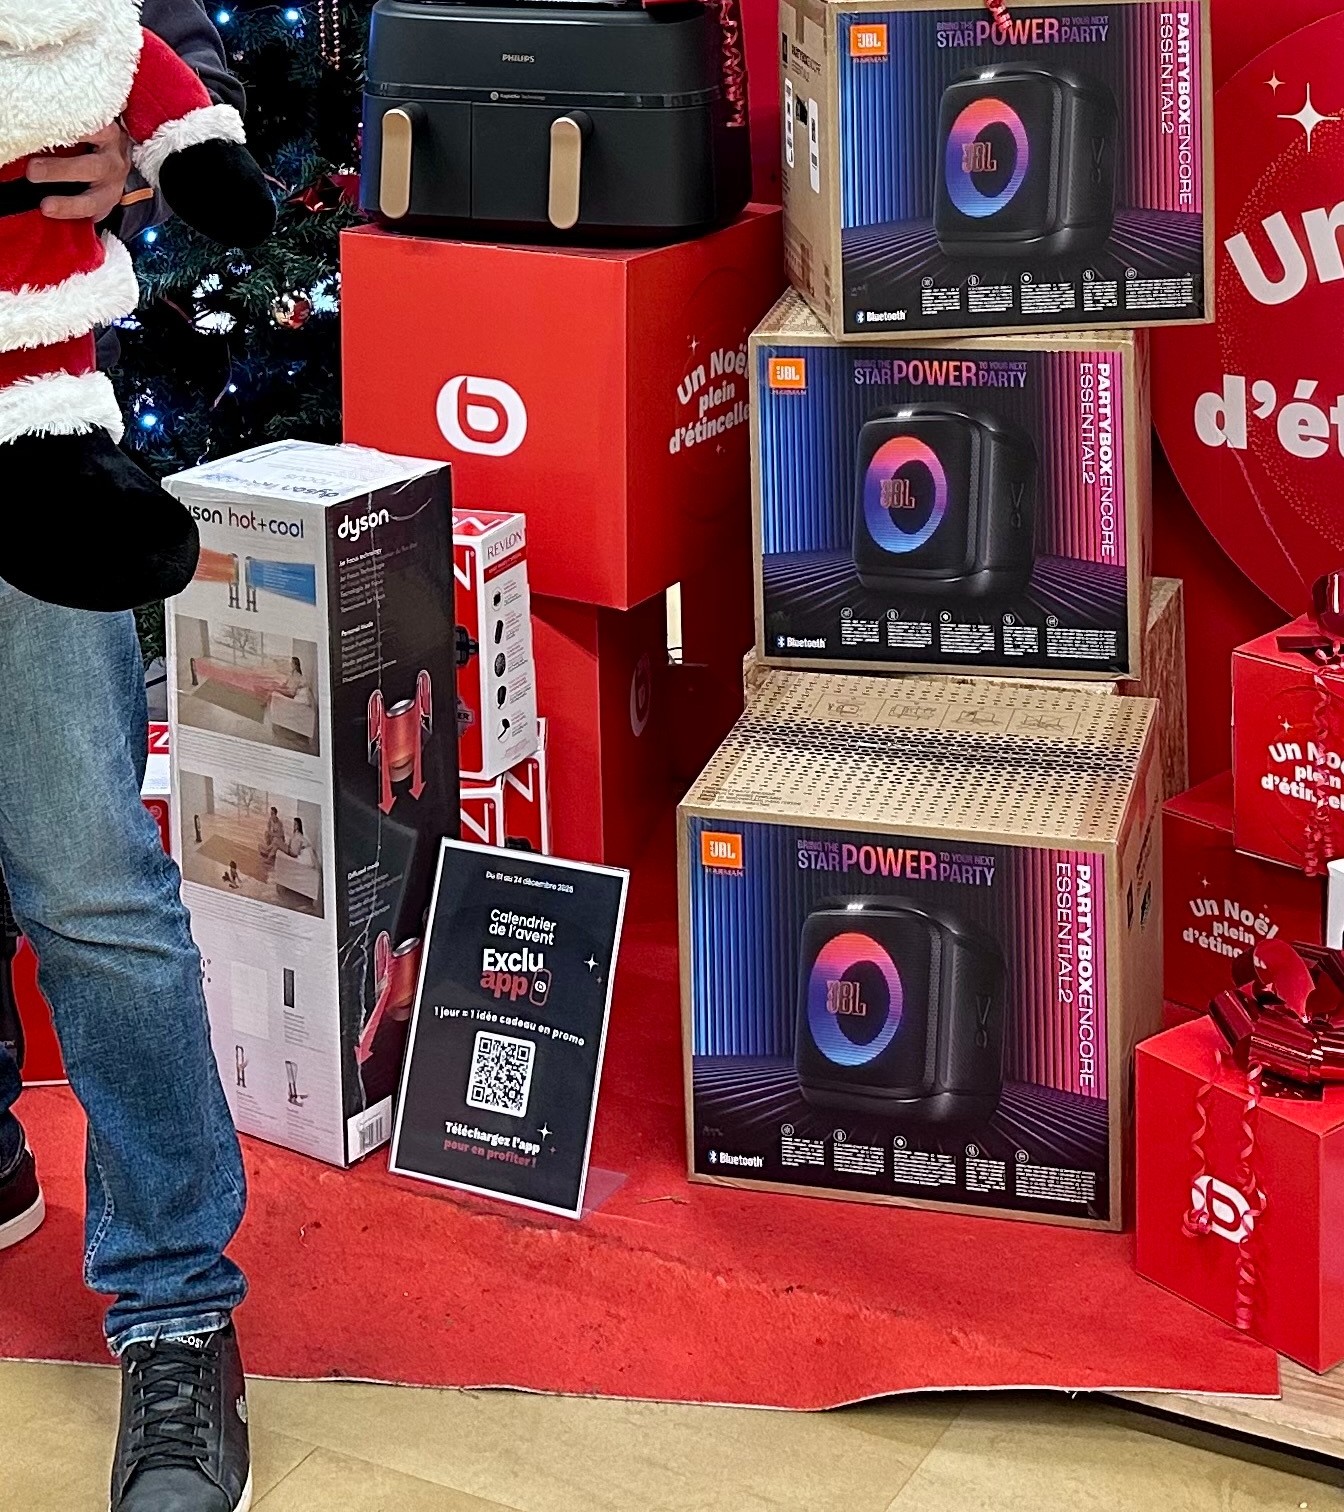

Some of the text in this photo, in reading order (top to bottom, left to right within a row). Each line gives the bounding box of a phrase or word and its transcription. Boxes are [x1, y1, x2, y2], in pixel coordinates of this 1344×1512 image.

[858, 33, 882, 49] JBL
[937, 18, 1109, 48] STAR POWER PARTY
[502, 53, 536, 64] PHILIPS
[676, 364, 706, 405] Un
[776, 366, 800, 381] JBL
[854, 359, 1027, 388] STAR POWER PARTY
[698, 379, 736, 419] plein
[337, 508, 390, 541] dyson
[487, 532, 522, 560] REVLON
[1268, 741, 1303, 763] Un
[709, 840, 736, 859] JBL
[974, 854, 995, 867] NEXT
[797, 843, 996, 887] STAR POWER PARTY
[490, 908, 557, 933] Calendrier
[1189, 898, 1279, 940] Un Noël
[489, 922, 554, 946] de l'avent
[1212, 921, 1255, 946] plein
[482, 947, 544, 973] Exclu
[479, 969, 529, 1001] app
[440, 1006, 585, 1047] jour cadeau en promo
[445, 1121, 541, 1156] Téléchargez l'app
[443, 1139, 531, 1166] pour en profiter
[719, 1152, 764, 1167] Bluetooth
